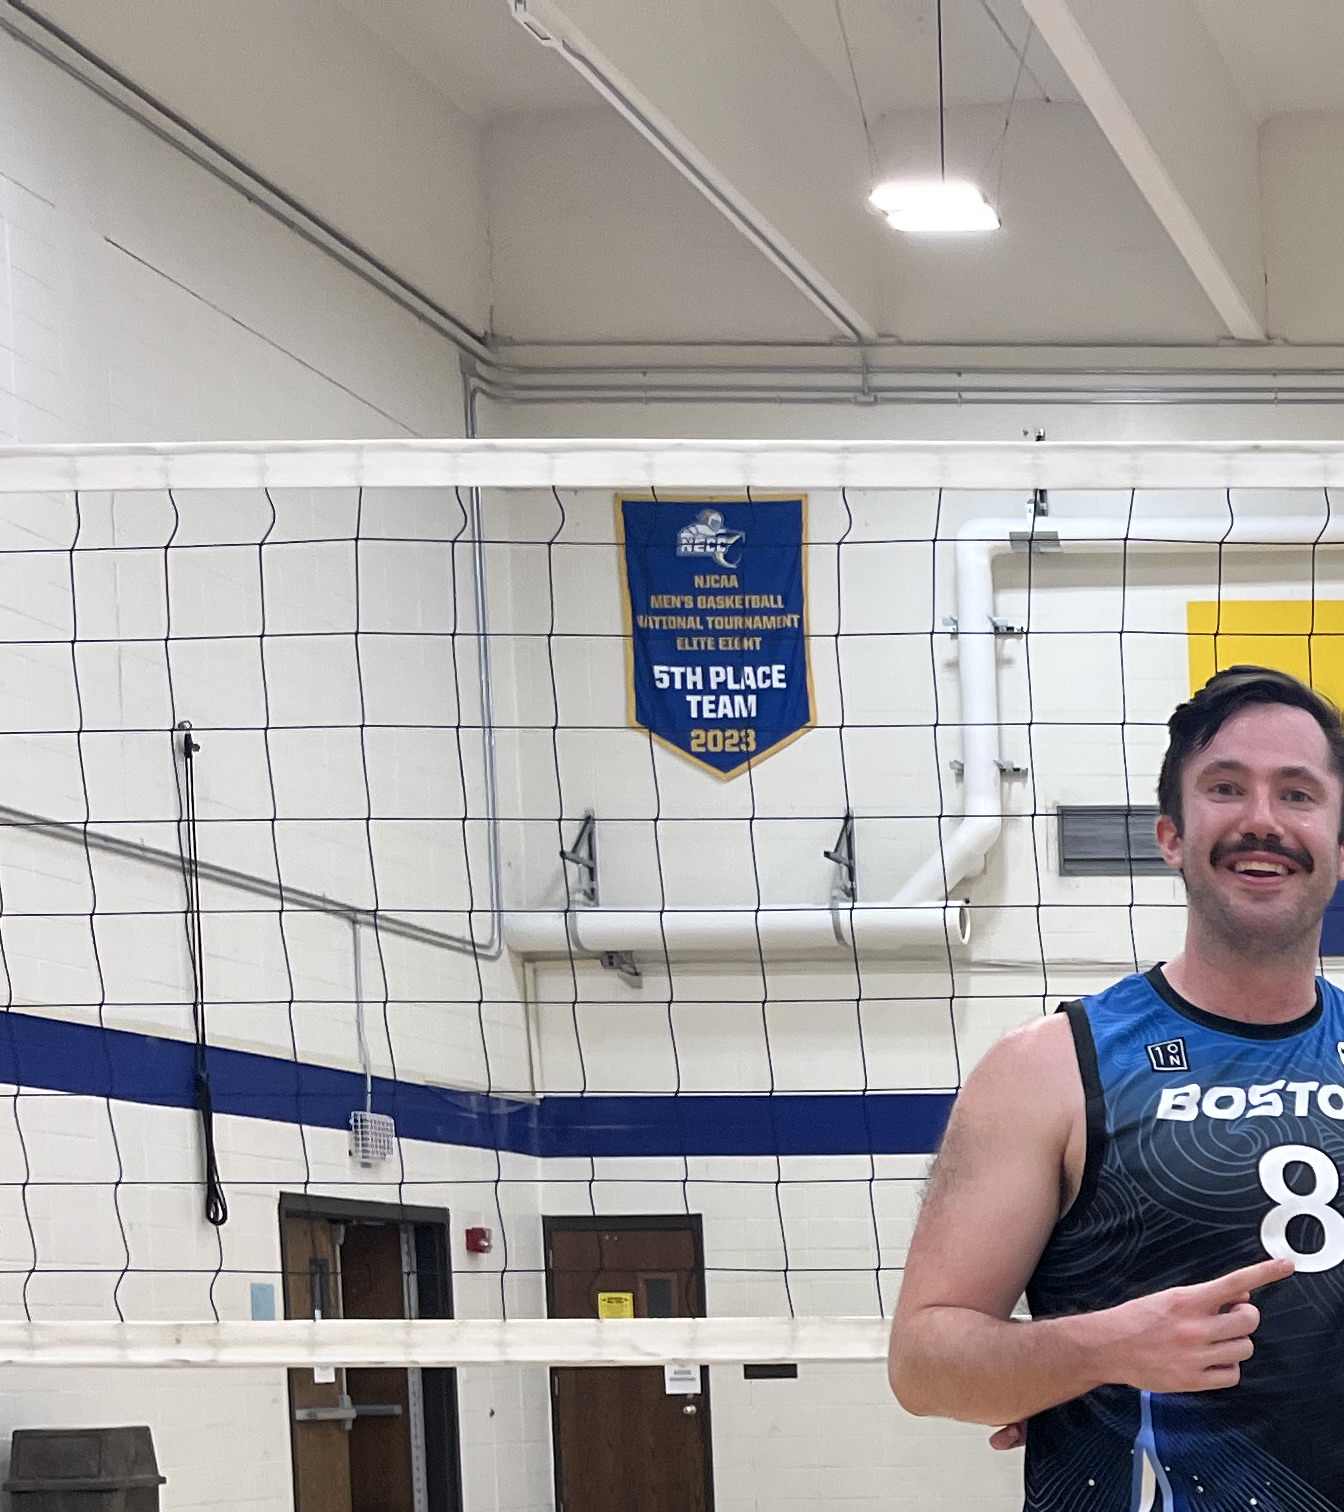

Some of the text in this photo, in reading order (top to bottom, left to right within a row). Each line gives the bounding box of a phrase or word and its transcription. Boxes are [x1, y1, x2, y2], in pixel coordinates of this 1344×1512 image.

[695, 575, 739, 588] NJCAA
[651, 595, 785, 609] MEN'S BASKETBALL
[706, 614, 800, 630] TOURNAMENT
[677, 636, 714, 650] ELITE
[653, 664, 787, 689] 5TH PLACE
[686, 694, 757, 718] TEAM
[691, 729, 757, 752] 2023
